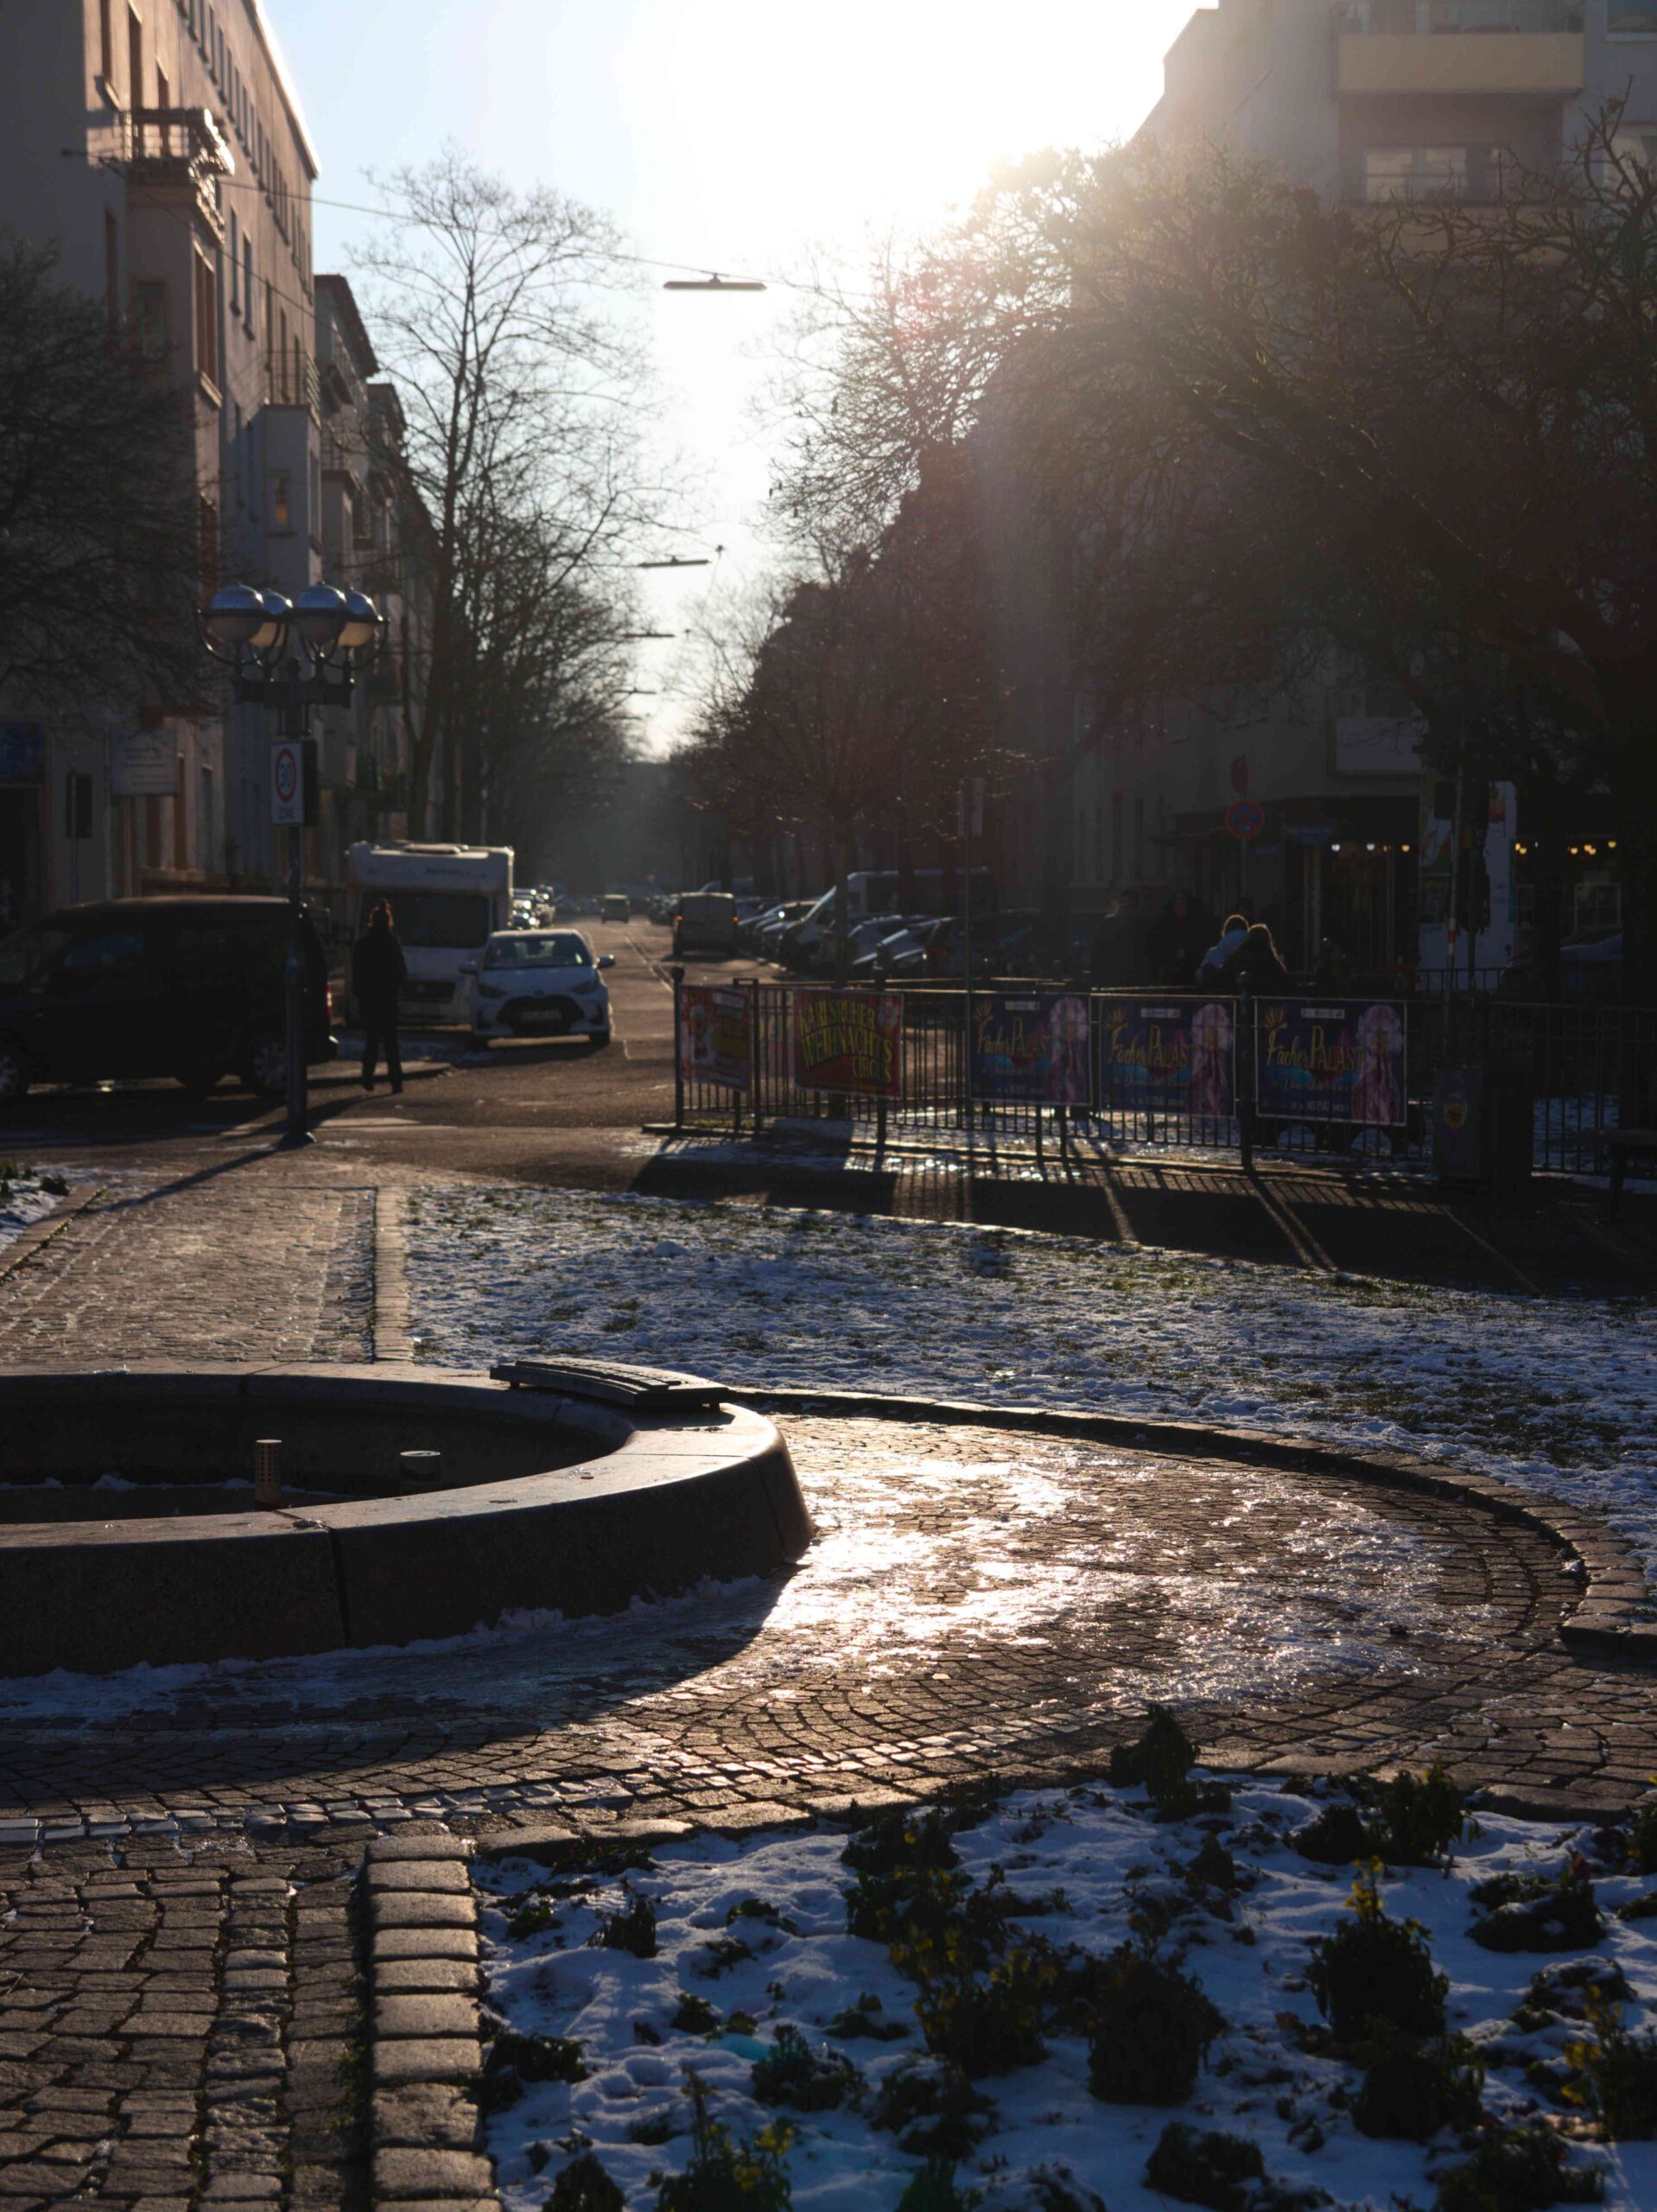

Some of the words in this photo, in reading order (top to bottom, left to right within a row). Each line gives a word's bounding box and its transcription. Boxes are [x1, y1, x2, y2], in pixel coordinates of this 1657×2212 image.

[280, 763, 293, 788] 30
[278, 806, 296, 821] ZONE
[799, 999, 876, 1037] KARLSRUHER
[801, 1026, 893, 1068] WEIHNACHTS
[1310, 1023, 1365, 1072] PALAST
[852, 1056, 892, 1084] CIRCUS
